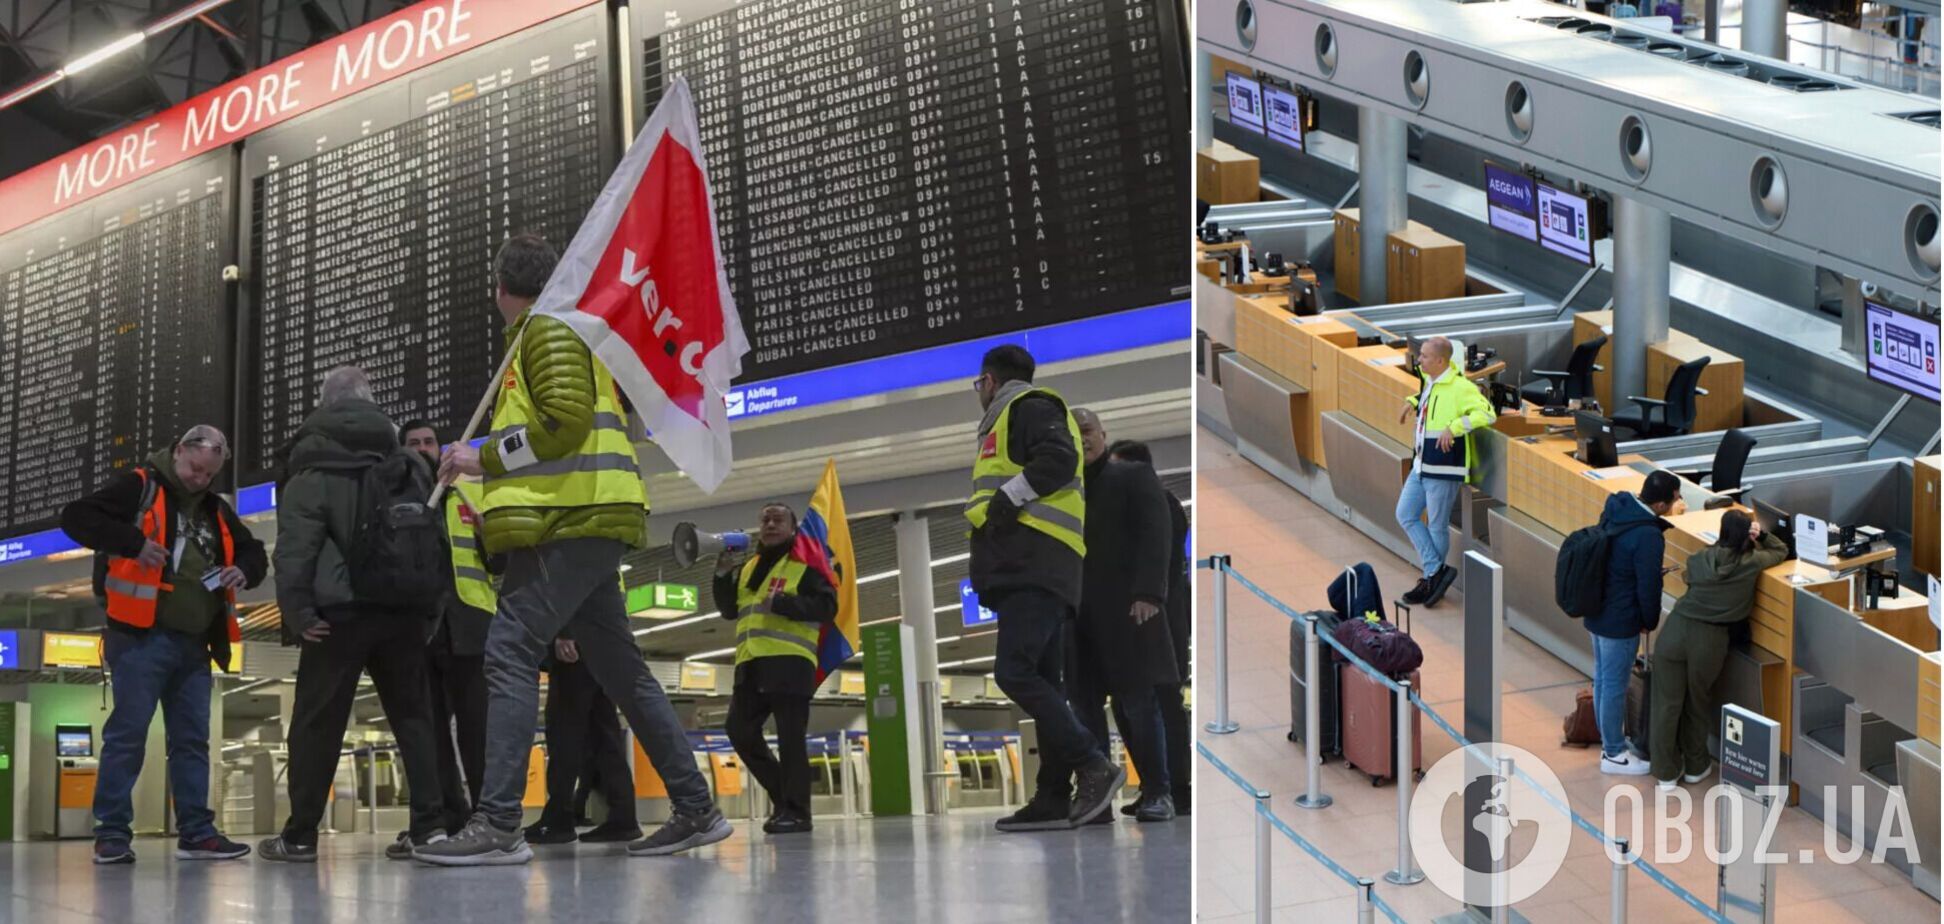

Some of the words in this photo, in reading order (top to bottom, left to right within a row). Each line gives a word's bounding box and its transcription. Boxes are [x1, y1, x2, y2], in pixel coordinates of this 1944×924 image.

[737, 0, 796, 19] GENF-CA
[703, 29, 722, 44] 413
[704, 56, 724, 71] 206
[704, 69, 724, 84] 352
[698, 83, 725, 100] 1202
[54, 122, 160, 204] MORE
[181, 61, 304, 152] MORE
[331, 0, 472, 91] MORE
[1489, 178, 1524, 200] AEGEAN
[746, 386, 778, 400] Abflug
[747, 396, 798, 413] Departures
